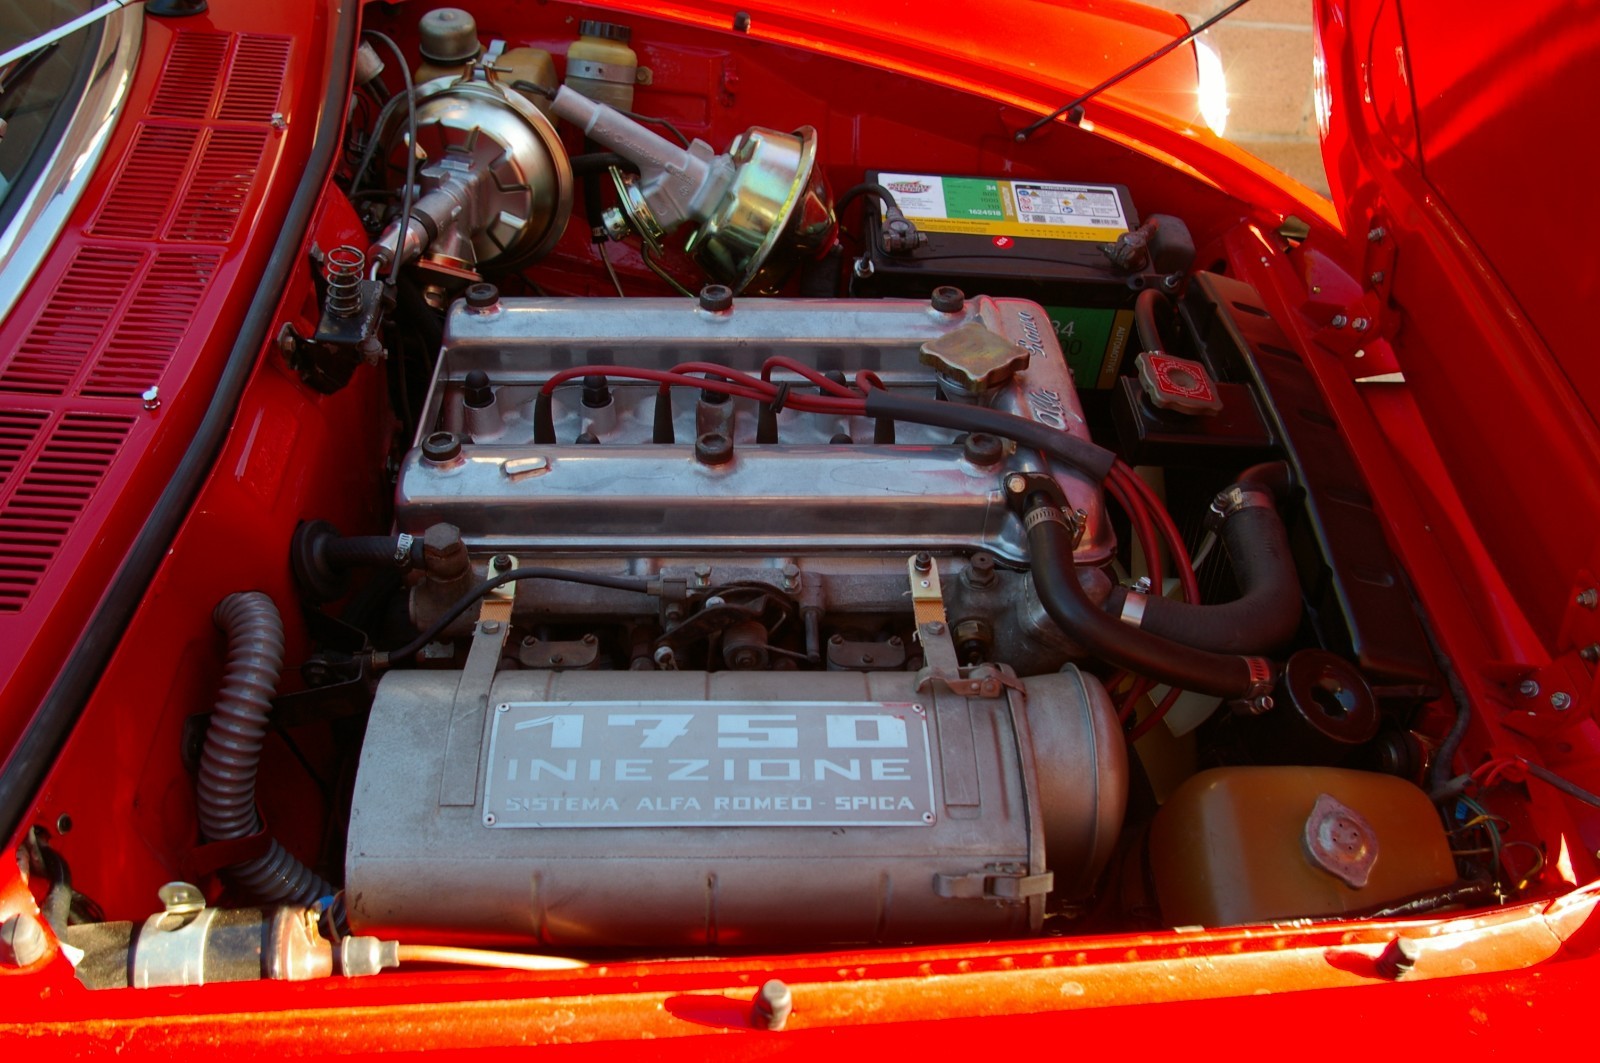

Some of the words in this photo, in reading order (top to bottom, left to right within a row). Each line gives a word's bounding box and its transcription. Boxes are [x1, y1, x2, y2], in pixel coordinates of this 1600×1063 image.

[1105, 325, 1126, 374] AUTOMOTIVE
[514, 713, 909, 749] 1750
[507, 758, 912, 782] INIEZIONE
[505, 796, 620, 812] SISTEMA
[636, 796, 702, 811] ALFA
[714, 796, 813, 811] ROMEO
[834, 796, 916, 811] SPICA
